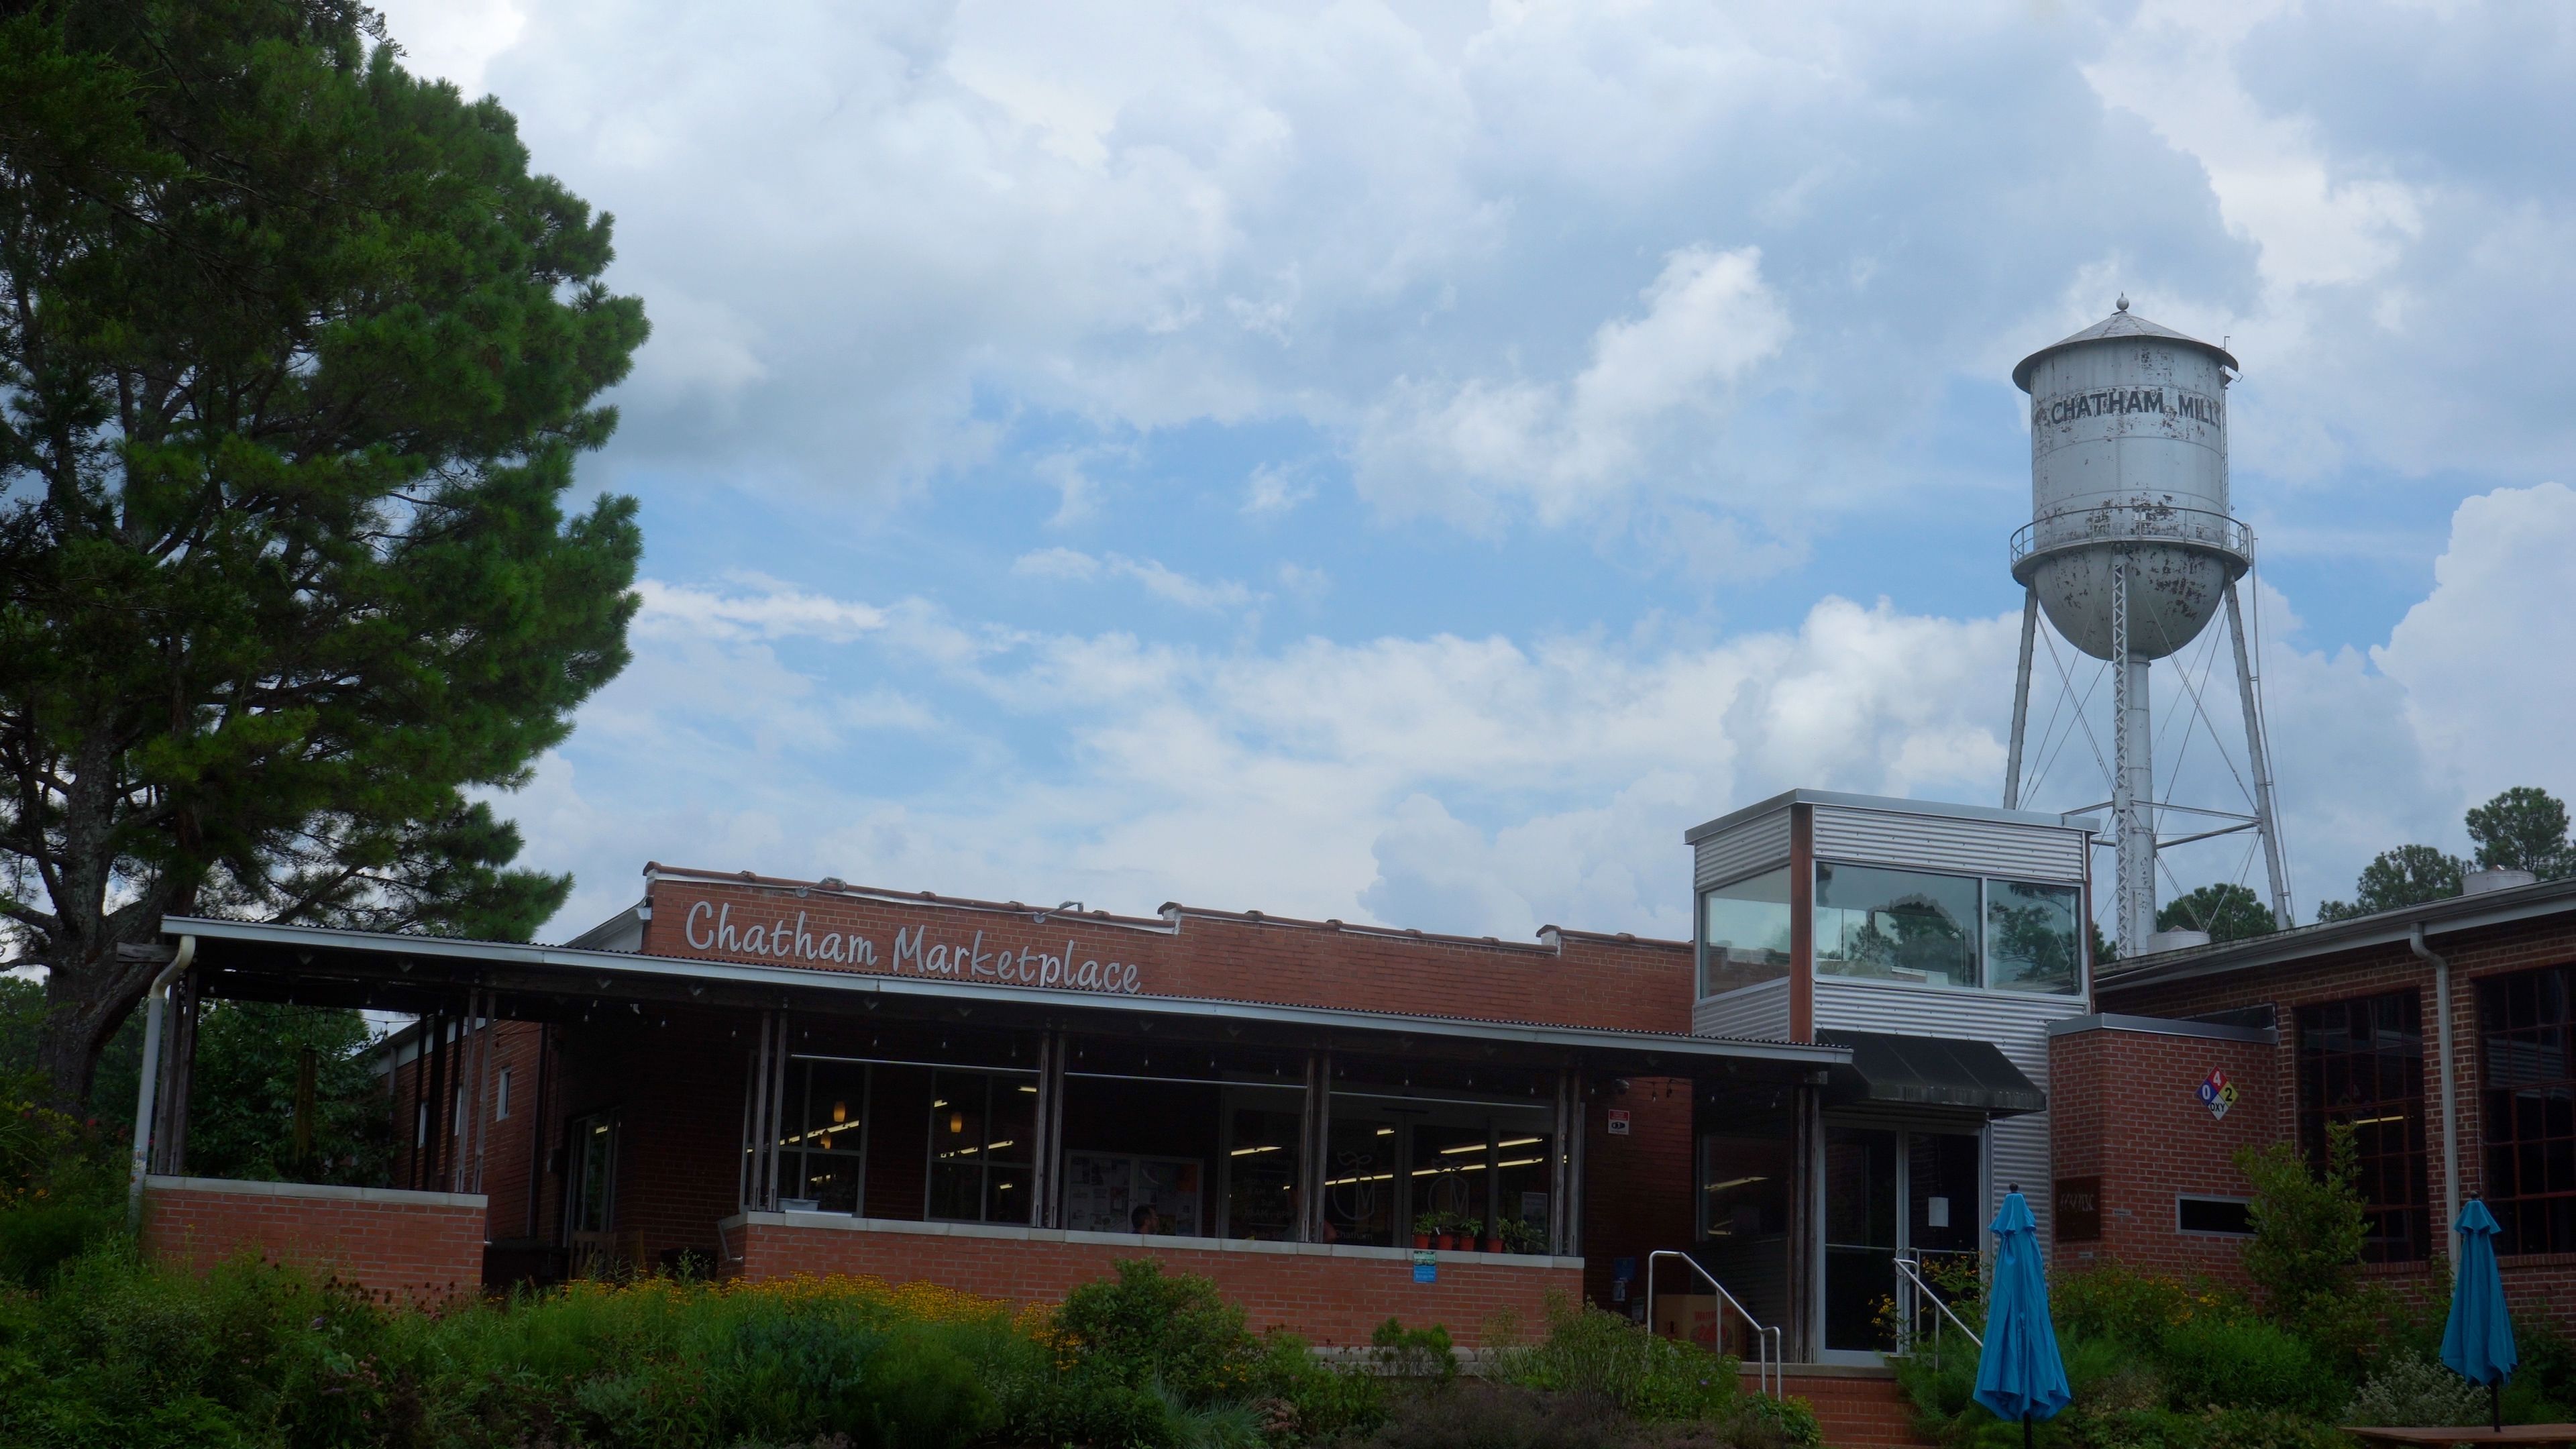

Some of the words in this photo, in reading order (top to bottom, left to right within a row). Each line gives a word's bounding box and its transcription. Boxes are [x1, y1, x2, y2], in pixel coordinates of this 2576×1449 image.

[2051, 390, 2163, 424] CHATHAM
[686, 900, 878, 967] Chatham
[892, 924, 1141, 994] Marketplace
[2212, 1071, 2222, 1086] 4
[2202, 1084, 2210, 1100] 0
[2224, 1087, 2233, 1102] 2
[2210, 1102, 2225, 1112] OXY
